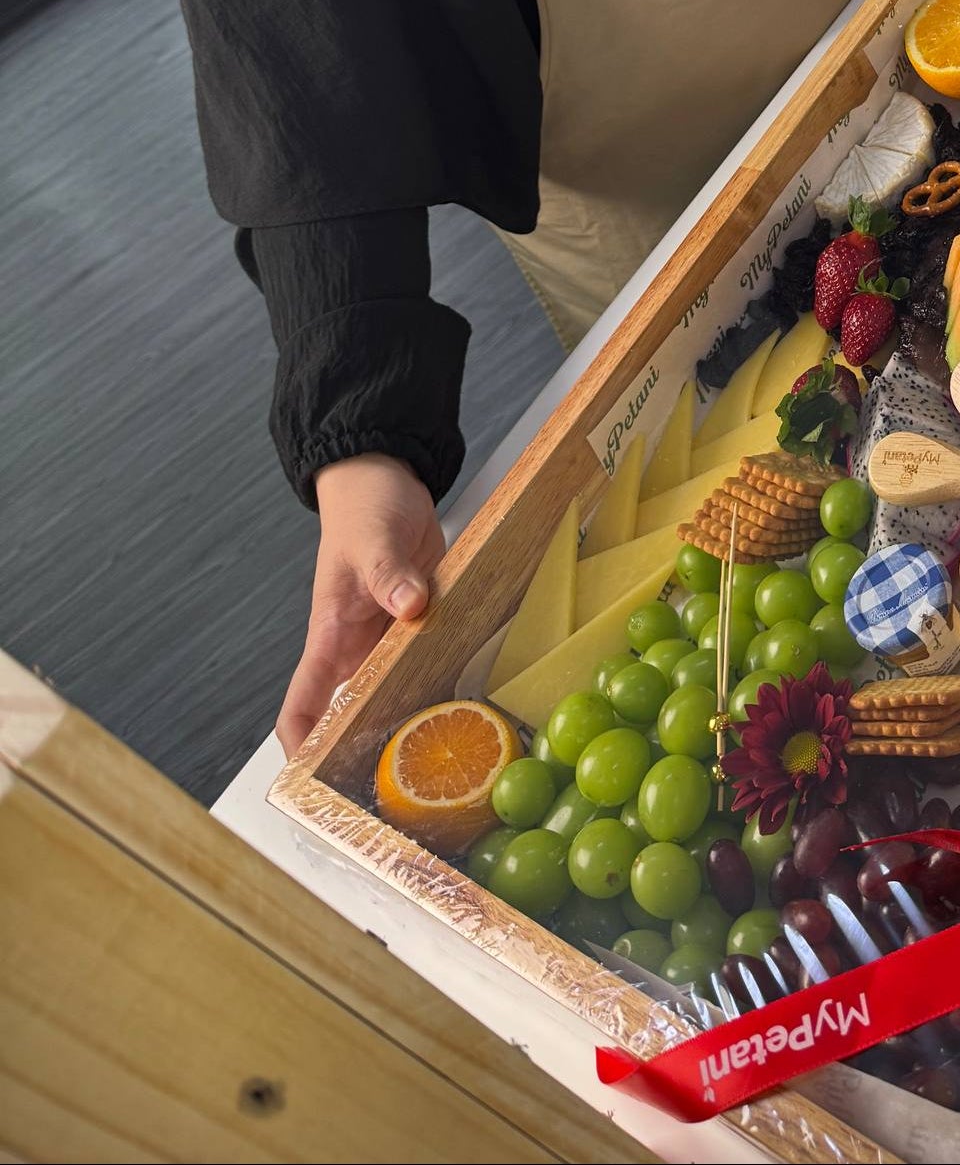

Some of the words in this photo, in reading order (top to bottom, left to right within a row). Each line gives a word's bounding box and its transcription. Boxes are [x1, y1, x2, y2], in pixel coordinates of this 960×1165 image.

[739, 173, 813, 291] MyPetani
[882, 450, 942, 466] MyPetani
[699, 992, 871, 1103] MyPetani
